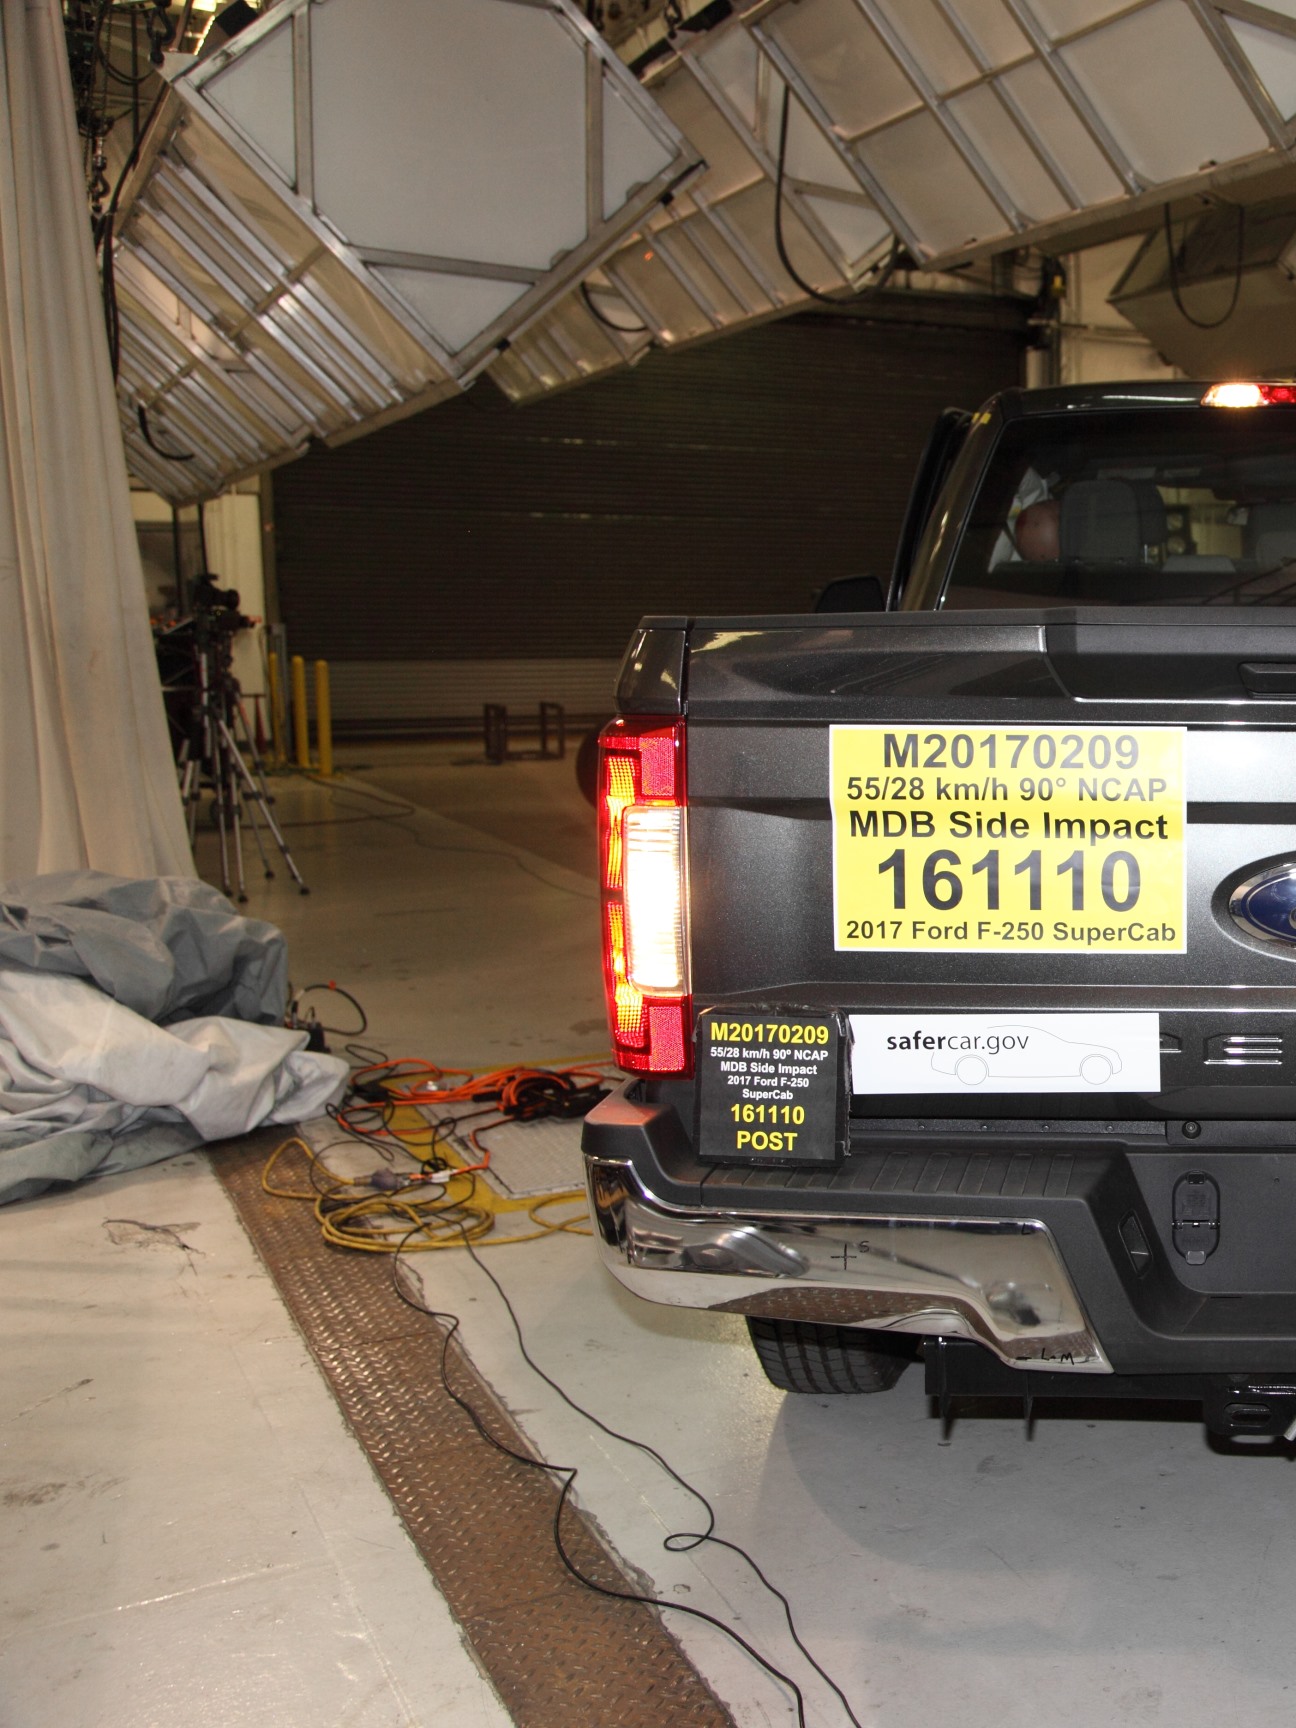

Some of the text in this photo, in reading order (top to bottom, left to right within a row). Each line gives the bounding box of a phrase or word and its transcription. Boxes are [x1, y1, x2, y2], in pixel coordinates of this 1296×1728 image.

[883, 733, 1139, 770] M20170209
[846, 776, 1168, 802] 55/28 km/h 90° NCAP
[849, 810, 1168, 846] MDB Side Impact
[878, 848, 1141, 912] 161110
[846, 920, 1176, 946] 2017 Ford F-250 SuperCab
[710, 1022, 829, 1045] M20170209
[886, 1030, 1030, 1055] safercar.gov
[710, 1046, 740, 1058] 55/28
[742, 1048, 770, 1060] km/h
[793, 1050, 829, 1061] NCAP
[720, 1061, 818, 1076] MDB Side Impact
[727, 1076, 810, 1088] 2017 Ford F-250
[742, 1088, 794, 1101] SuperCab
[730, 1103, 806, 1125] 161110
[736, 1130, 798, 1151] POST
